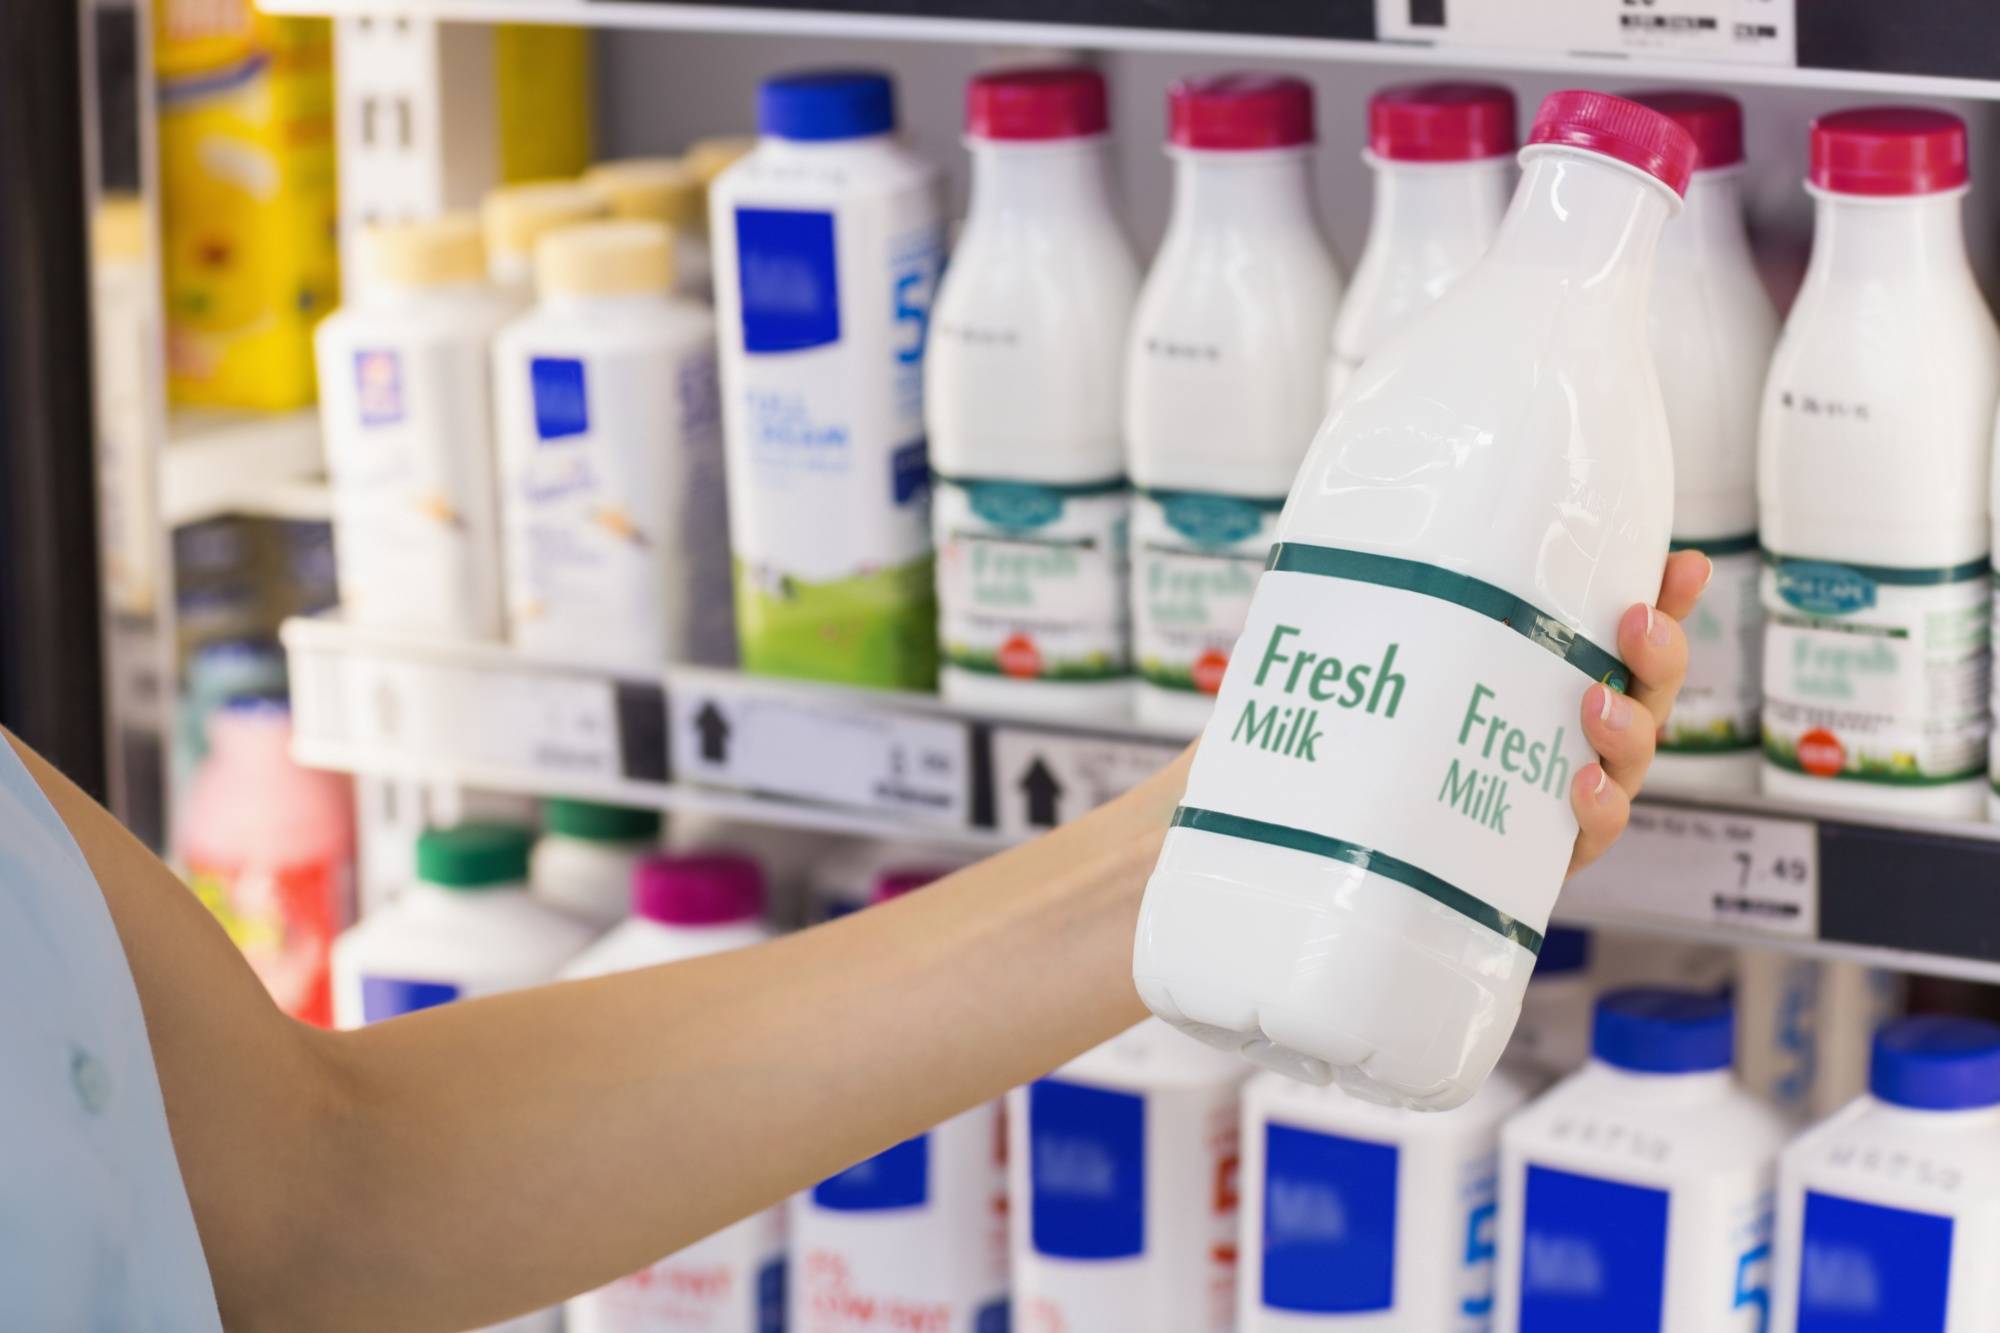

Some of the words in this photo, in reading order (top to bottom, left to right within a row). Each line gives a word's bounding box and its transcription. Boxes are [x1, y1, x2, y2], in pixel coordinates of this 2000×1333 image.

[1253, 624, 1406, 719] Fresh
[1231, 699, 1324, 762] Milk
[1457, 682, 1570, 800] Fresh
[1438, 758, 1512, 835] Milk
